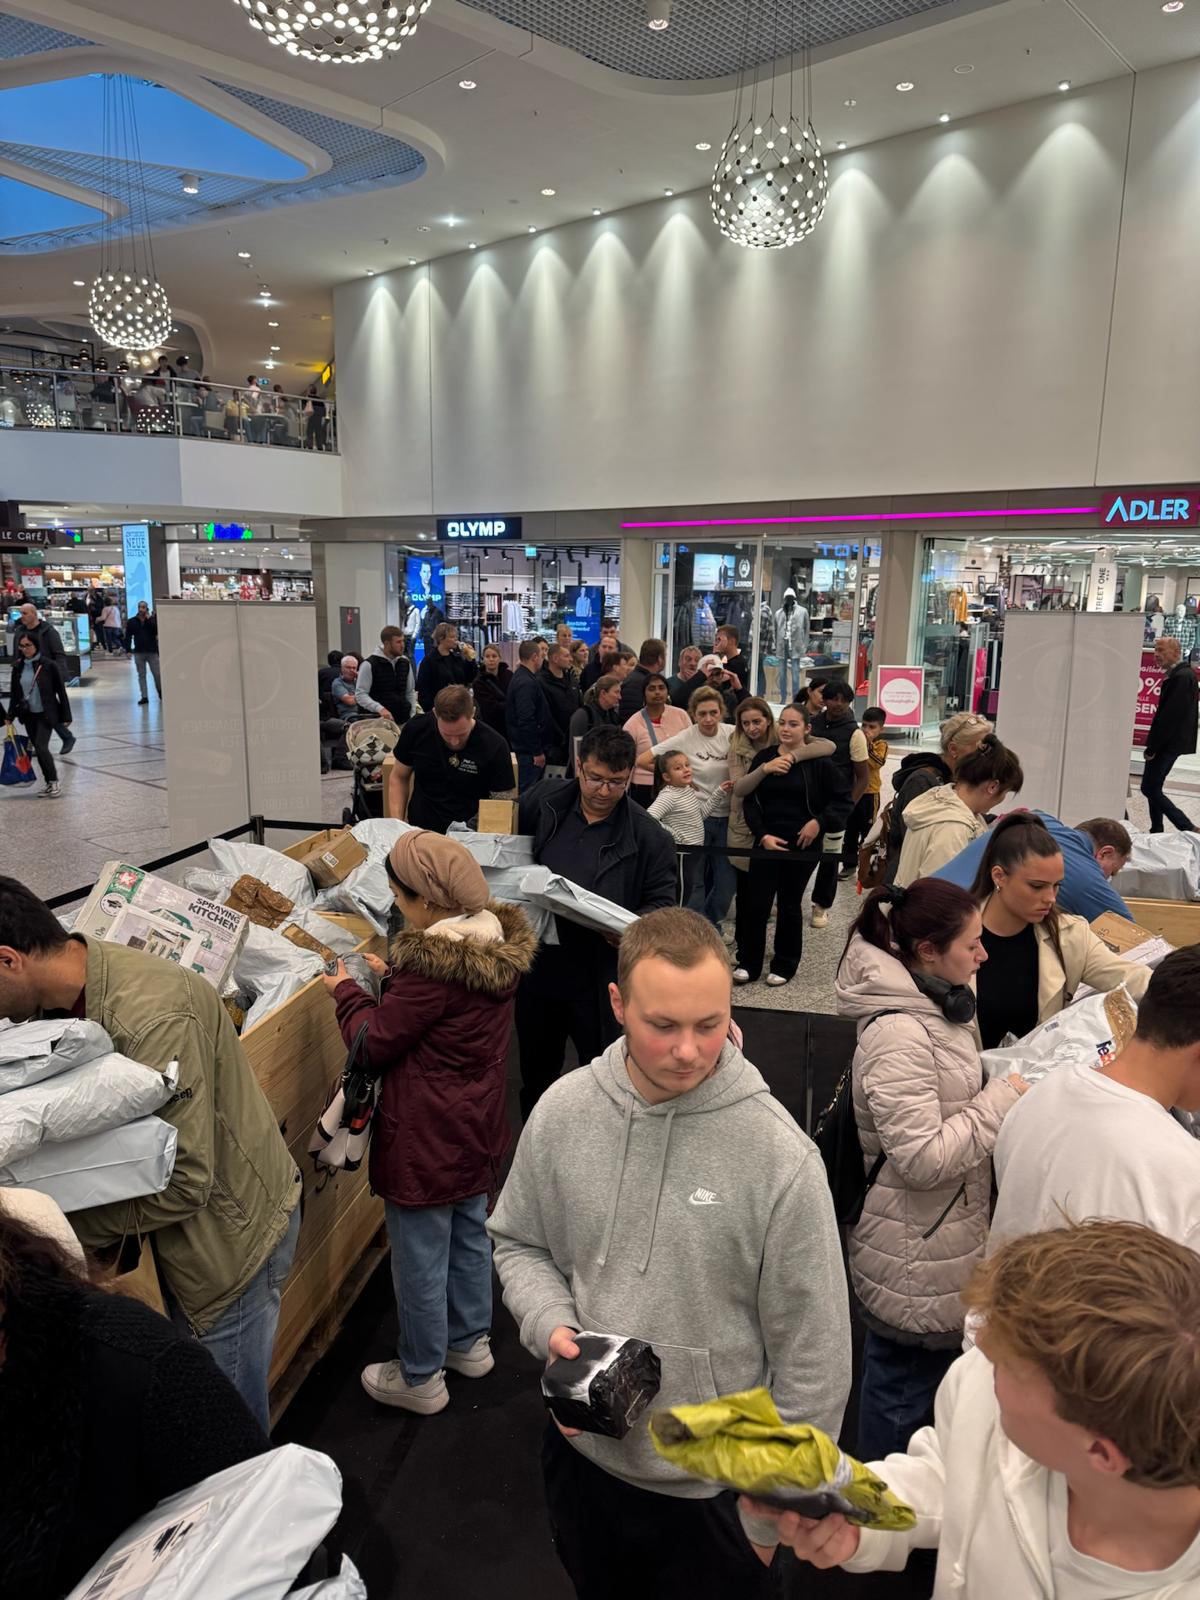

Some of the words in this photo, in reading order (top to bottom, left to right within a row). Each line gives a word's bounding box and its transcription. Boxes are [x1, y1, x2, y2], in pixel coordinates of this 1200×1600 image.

[1105, 496, 1190, 522] ADLER
[2, 531, 12, 540] LE
[17, 530, 42, 541] CAFÉ
[447, 521, 506, 537] OLYMP
[126, 538, 146, 549] NEUE
[1095, 586, 1105, 610] TREET
[188, 903, 238, 933] KITCHEN
[196, 898, 241, 924] SPRAYING
[694, 1187, 717, 1201] NIKE
